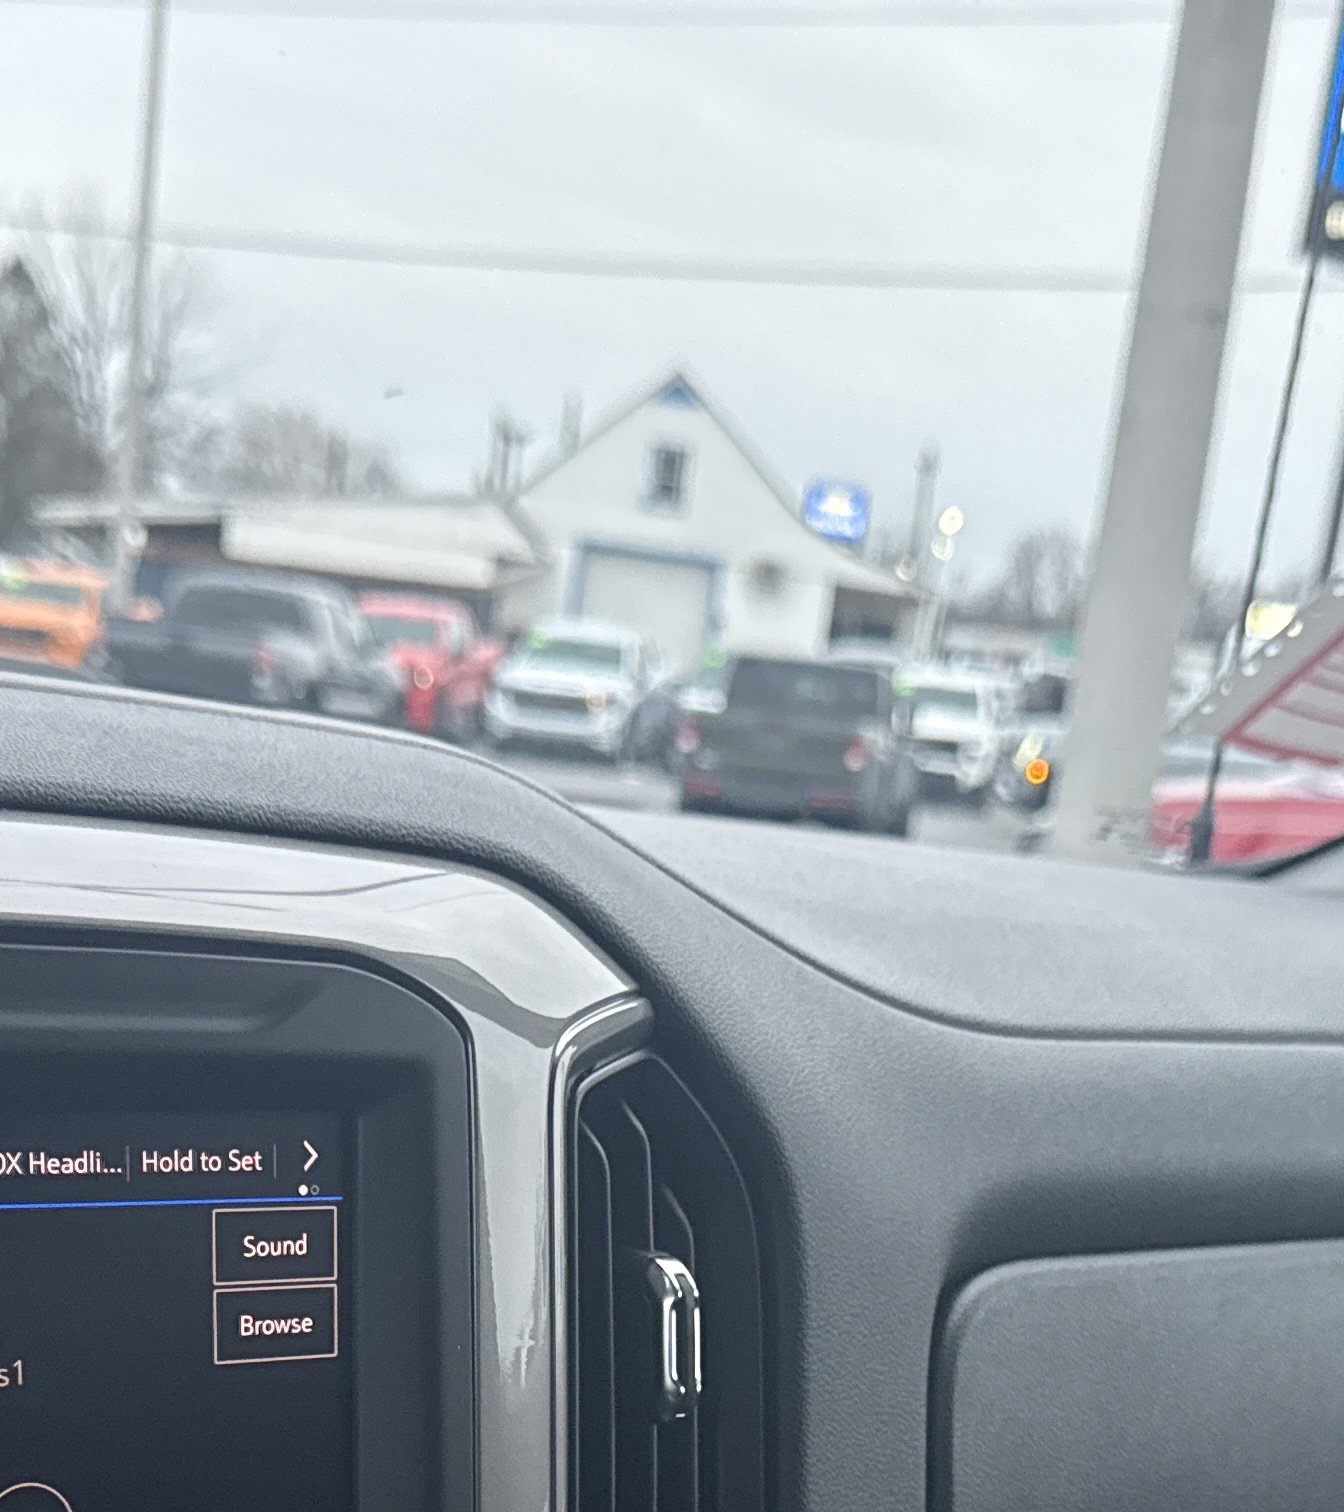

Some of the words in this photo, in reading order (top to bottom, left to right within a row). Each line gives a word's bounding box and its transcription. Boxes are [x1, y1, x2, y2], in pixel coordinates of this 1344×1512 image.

[28, 1149, 123, 1176] Headli...
[142, 1148, 194, 1174] Hold
[199, 1151, 223, 1173] to
[228, 1147, 264, 1173] Set
[242, 1231, 309, 1259] Sound
[240, 1312, 315, 1338] Browse
